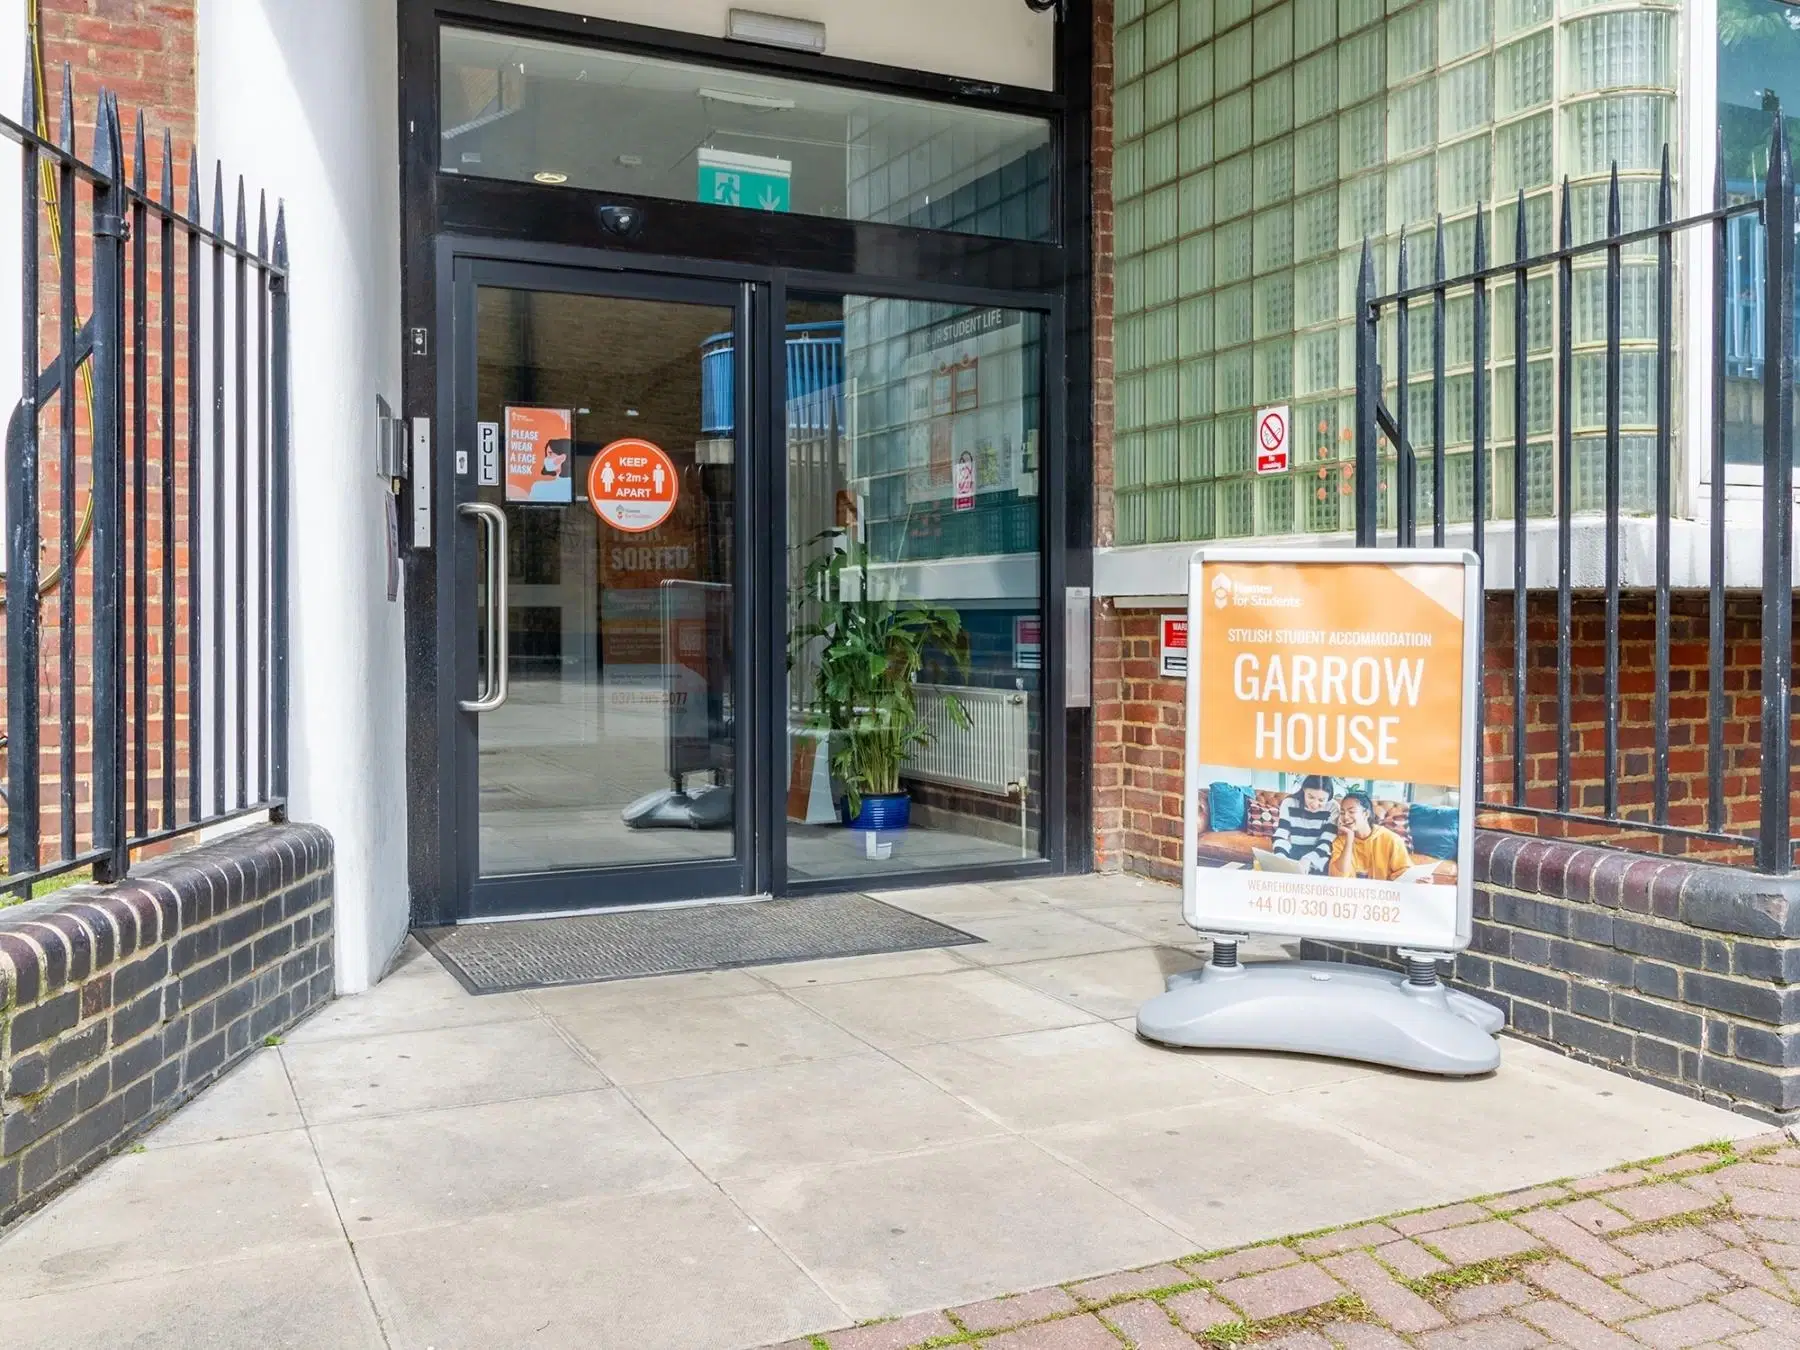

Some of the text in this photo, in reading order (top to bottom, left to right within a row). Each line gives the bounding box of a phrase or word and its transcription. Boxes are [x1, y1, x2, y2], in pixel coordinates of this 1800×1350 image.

[943, 315, 982, 340] STUDENT
[983, 309, 1002, 328] LIFE
[511, 429, 539, 441] PLEASE
[483, 427, 493, 480] PULL
[511, 441, 533, 452] WEAR
[510, 452, 537, 465] A FACE
[619, 456, 648, 468] KEEP
[510, 464, 533, 475] MASK
[625, 472, 641, 483] 2m
[615, 487, 652, 498] APART
[611, 545, 696, 571] SORTED.
[1232, 595, 1302, 607] for Students
[1228, 628, 1432, 648] STYLISH STUDENT ACCOMMODATION
[1234, 653, 1424, 706] GARROW
[1255, 712, 1399, 765] HOUSE
[1248, 880, 1401, 902] WEAREHOMESFORSTUDENTS.COM
[1248, 896, 1401, 923] +44 (0) 330 057 3682
